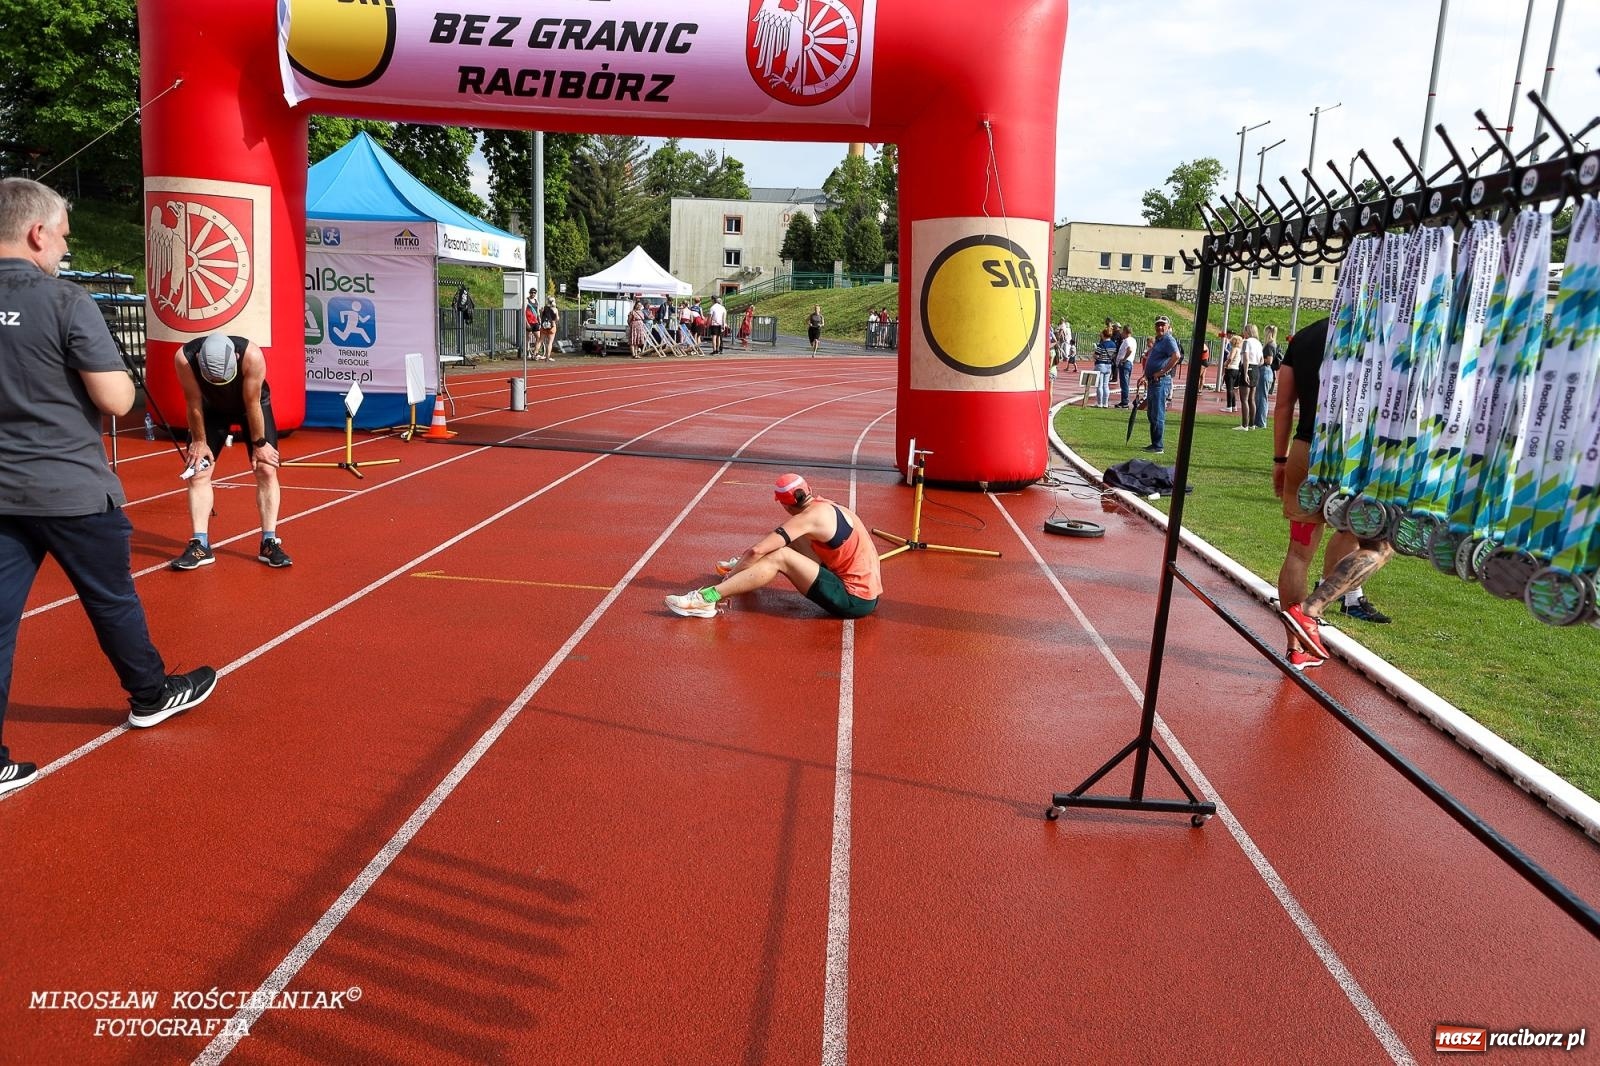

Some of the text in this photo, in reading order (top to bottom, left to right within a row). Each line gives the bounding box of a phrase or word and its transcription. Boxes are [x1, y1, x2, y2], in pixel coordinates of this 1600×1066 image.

[429, 12, 699, 54] BEZ GRANIC
[457, 62, 676, 103] RACIBÓRZ
[394, 237, 420, 246] MITKO
[982, 260, 1040, 289] SIR
[1406, 255, 1415, 279] GRANIC
[0, 311, 21, 326] RZ
[338, 349, 368, 358] TRENINGI
[338, 358, 369, 367] BIEGOWE
[1360, 368, 1370, 399] Racibórz
[1444, 374, 1456, 410] Racibórz
[1330, 384, 1338, 414] Racibórz
[1528, 384, 1552, 457] Racibórz OSiR
[1552, 386, 1576, 462] Racibórz OSiR
